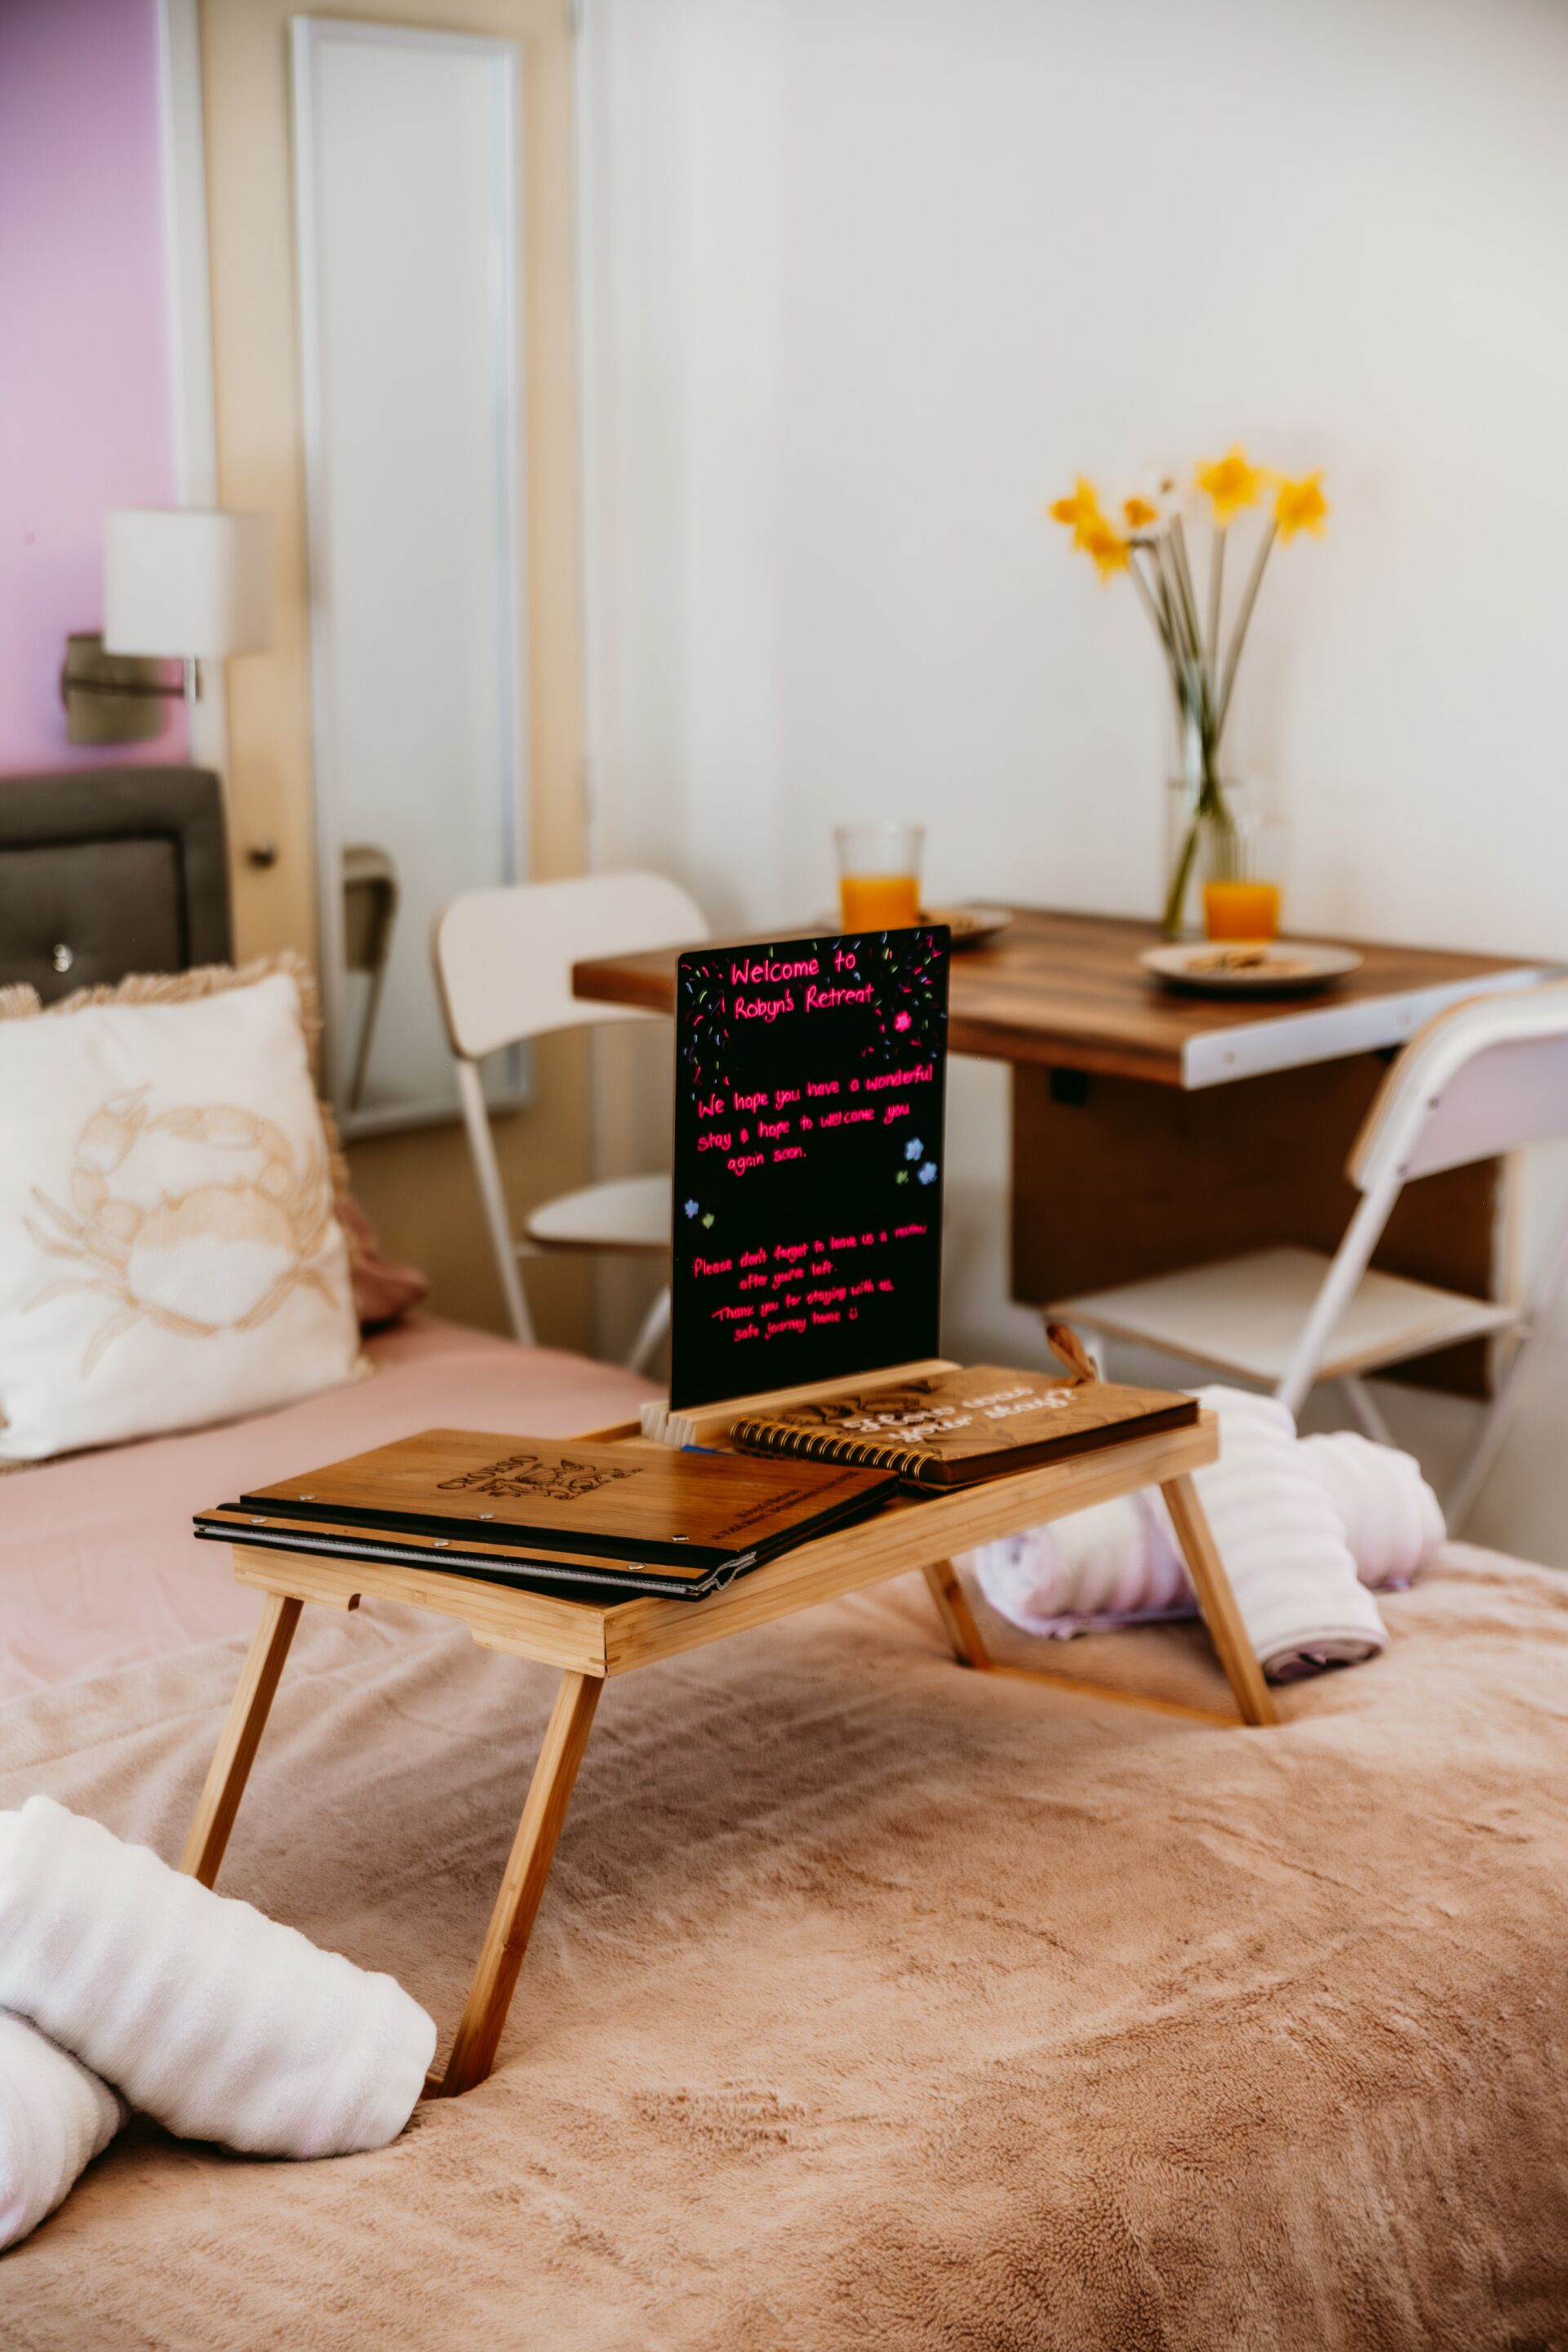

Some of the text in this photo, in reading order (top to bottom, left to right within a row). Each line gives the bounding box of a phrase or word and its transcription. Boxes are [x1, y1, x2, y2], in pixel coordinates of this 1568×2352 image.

[731, 950, 855, 986] Welcome to
[735, 983, 874, 1022] Robyn's Retreat
[699, 1064, 932, 1118] We hope you have a wonderful
[698, 1132, 731, 1151] stay
[757, 1121, 789, 1140] hope
[800, 1115, 812, 1131] to
[820, 1109, 874, 1127] welcome
[883, 1104, 909, 1124] you
[727, 1147, 806, 1176] again soon.
[694, 1257, 732, 1278] Please
[740, 1247, 767, 1267] don't
[774, 1243, 809, 1263] forget
[814, 1241, 824, 1252] to
[830, 1236, 857, 1249] leave
[861, 1234, 874, 1244] us
[880, 1232, 886, 1241] a
[712, 1306, 754, 1320] Thank
[761, 1302, 779, 1317] you
[785, 1294, 801, 1307] for
[806, 1287, 846, 1305] staying
[851, 1280, 873, 1296] with
[740, 1274, 767, 1290] after
[735, 1312, 840, 1341] safe journey home
[437, 1455, 538, 1490] CROESO
